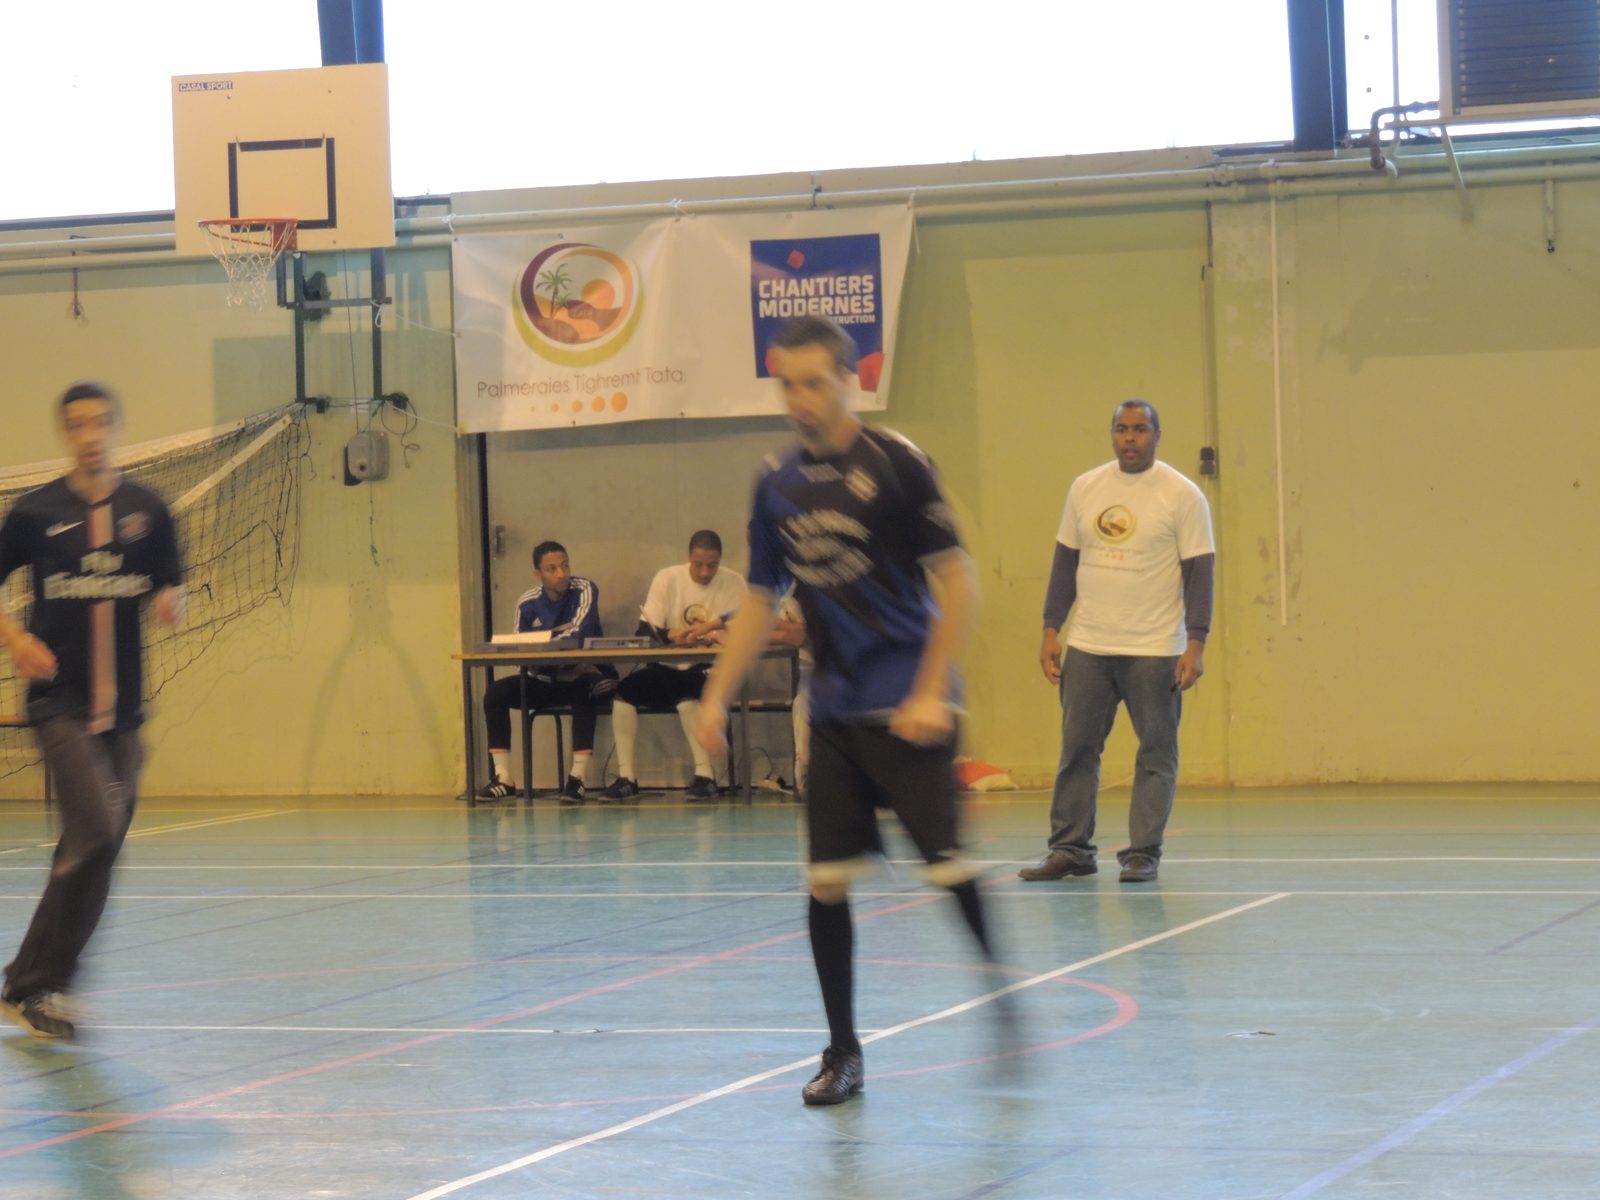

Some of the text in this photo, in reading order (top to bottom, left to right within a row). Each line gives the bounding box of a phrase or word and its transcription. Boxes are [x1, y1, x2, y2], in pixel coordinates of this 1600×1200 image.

[180, 81, 232, 91] CASAL SPORT
[759, 275, 874, 298] CHANTIERS
[759, 295, 875, 318] MODERNES
[831, 315, 876, 325] TRUCTION
[477, 366, 684, 398] Palmeraies Tighremt Tata
